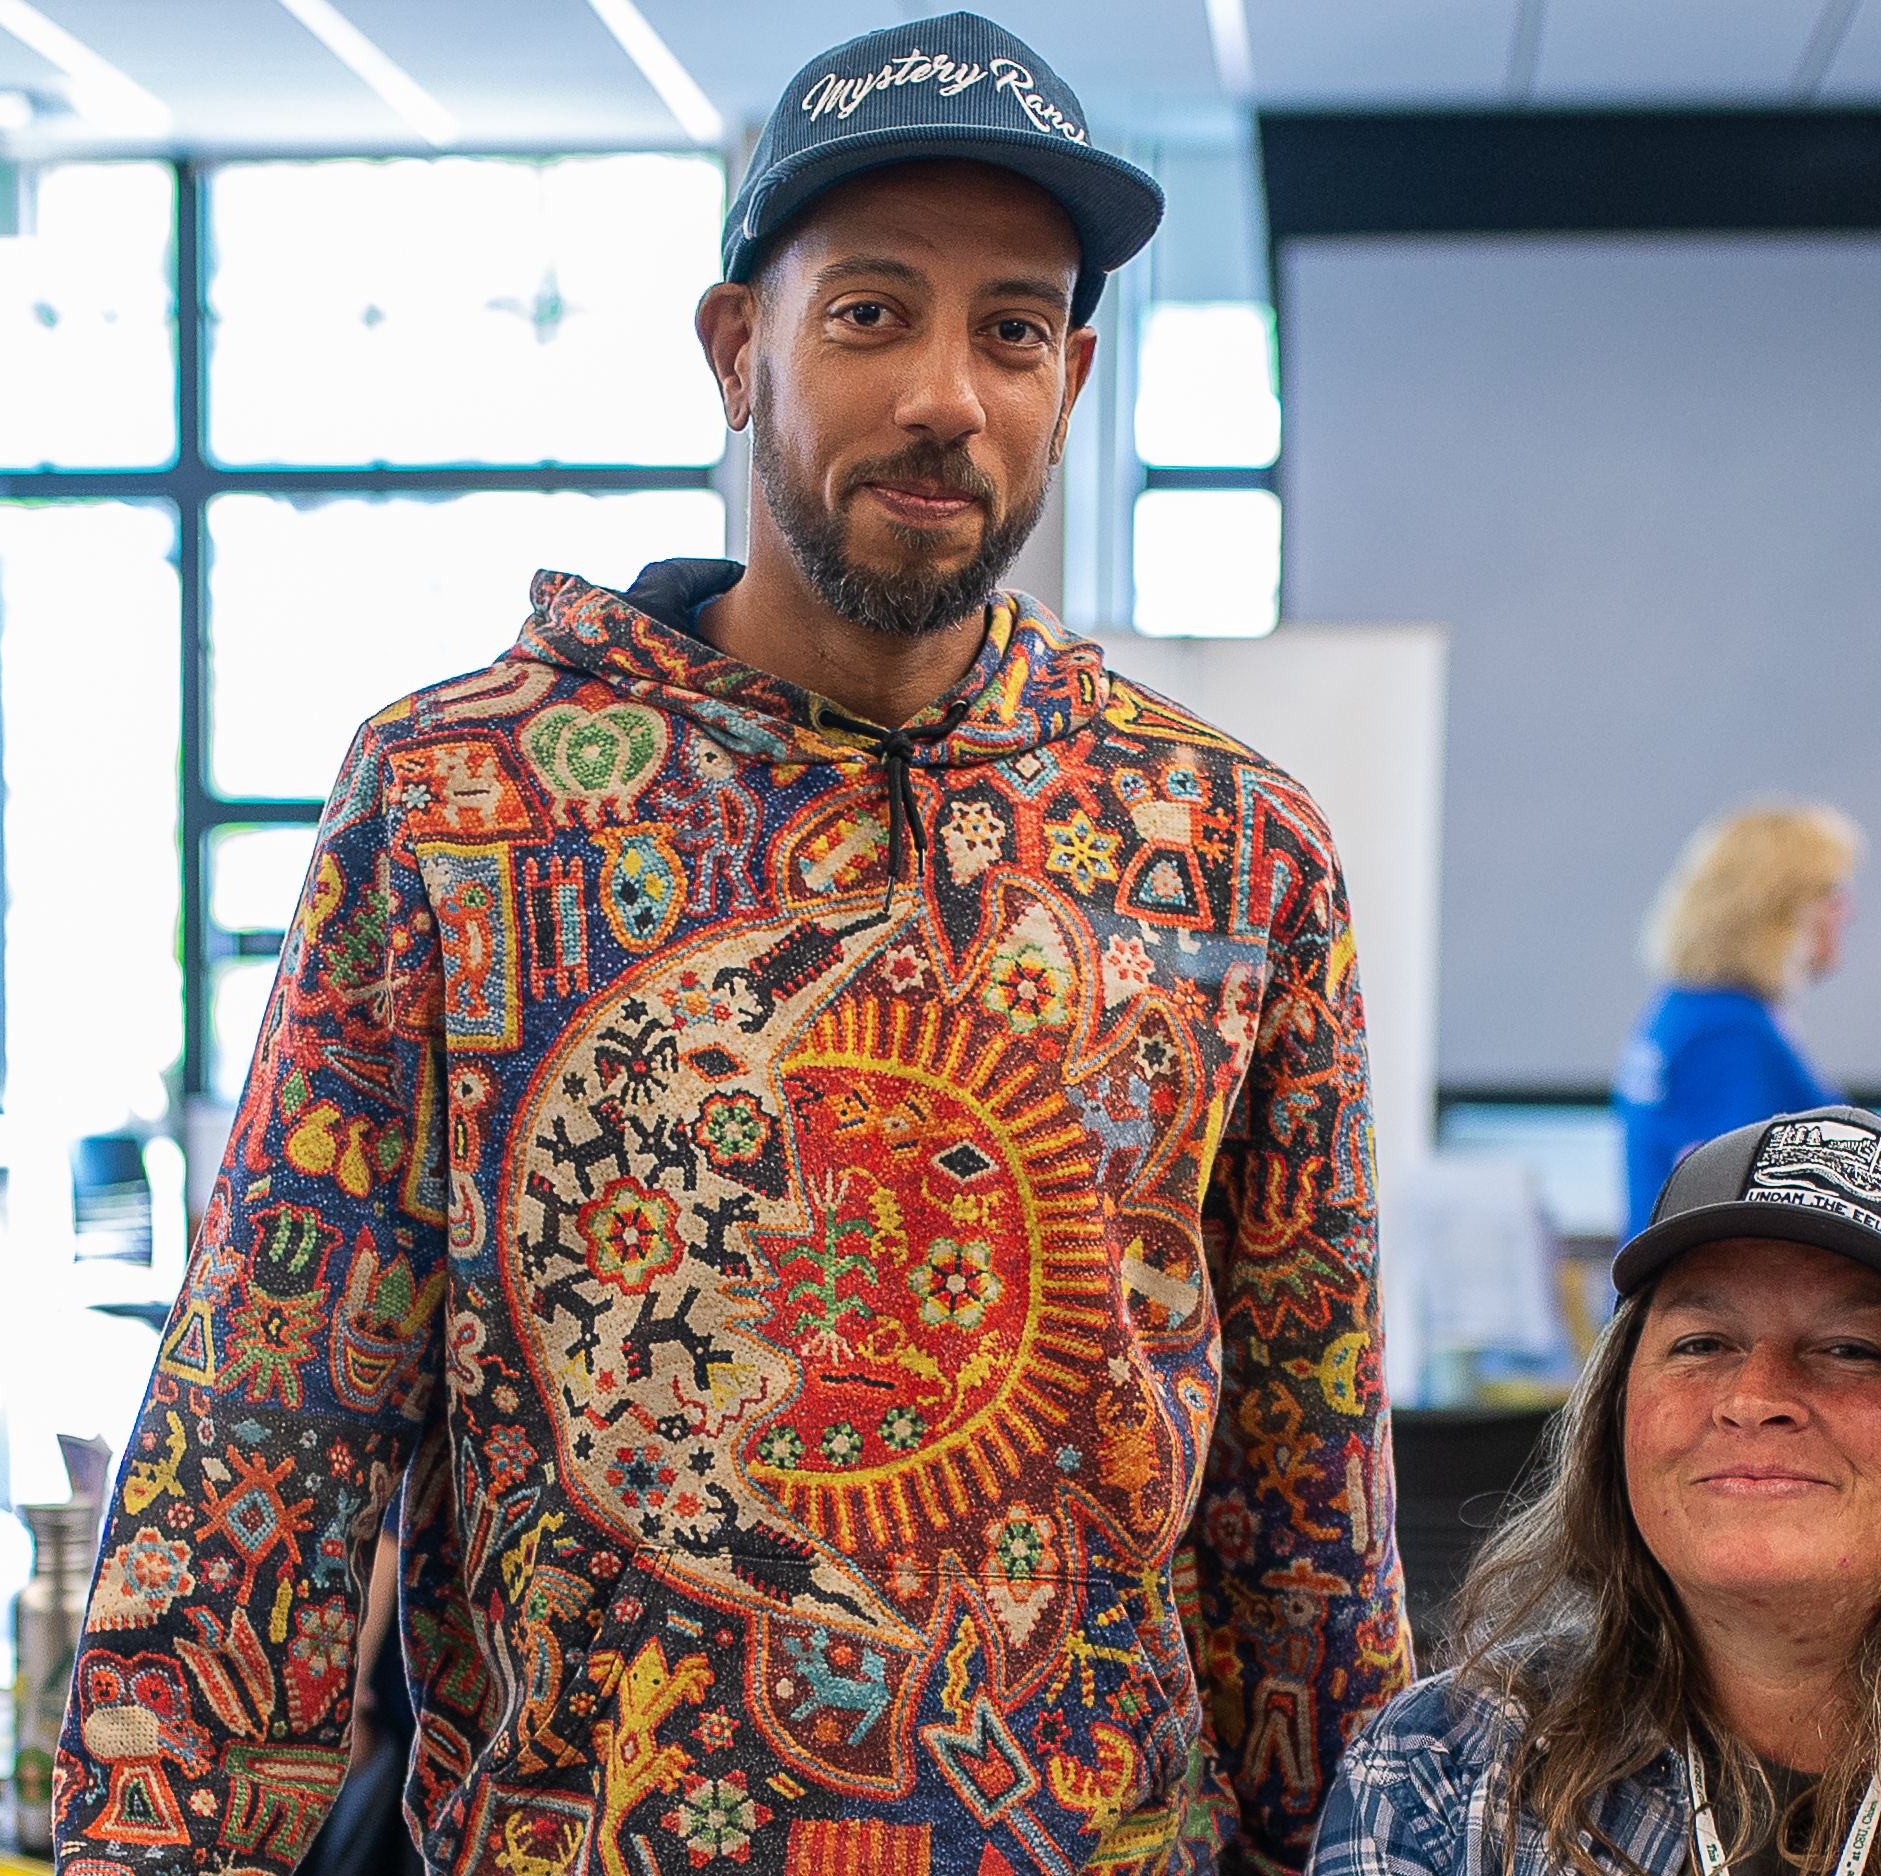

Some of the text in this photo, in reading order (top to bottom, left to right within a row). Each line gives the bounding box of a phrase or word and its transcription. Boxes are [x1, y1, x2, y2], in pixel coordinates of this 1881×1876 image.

[802, 48, 988, 122] Mystery
[1748, 1190, 1804, 1205] UNDAM
[1810, 1195, 1847, 1216] THE
